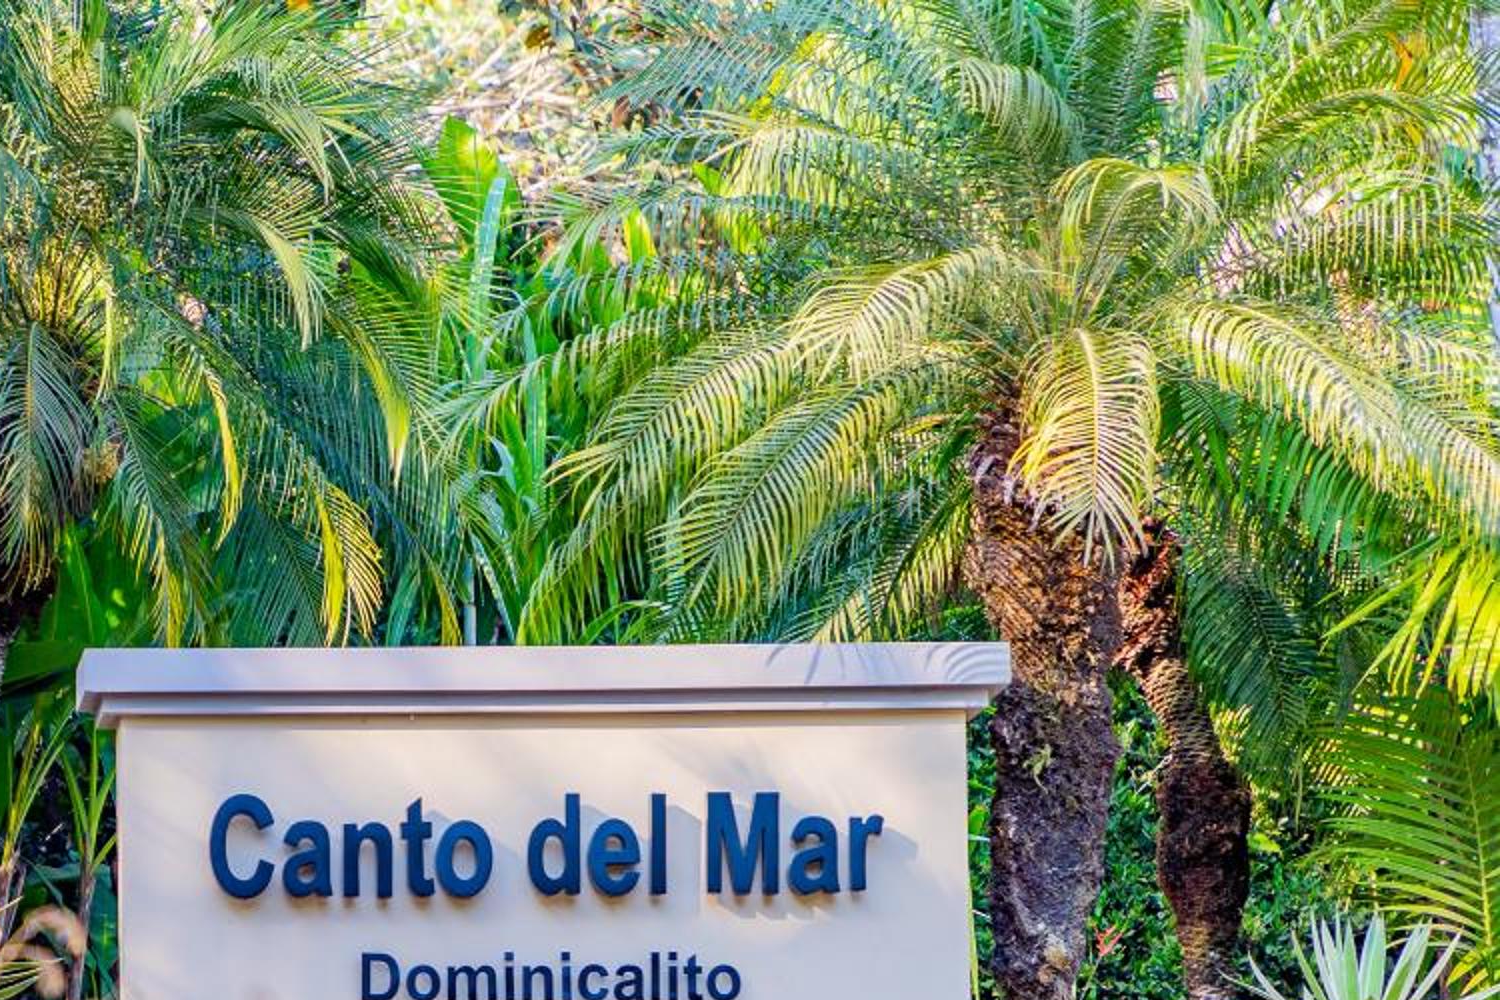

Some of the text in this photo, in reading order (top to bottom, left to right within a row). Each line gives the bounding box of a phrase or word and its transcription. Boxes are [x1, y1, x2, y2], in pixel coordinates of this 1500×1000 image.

[209, 791, 884, 899] Canto del Mar
